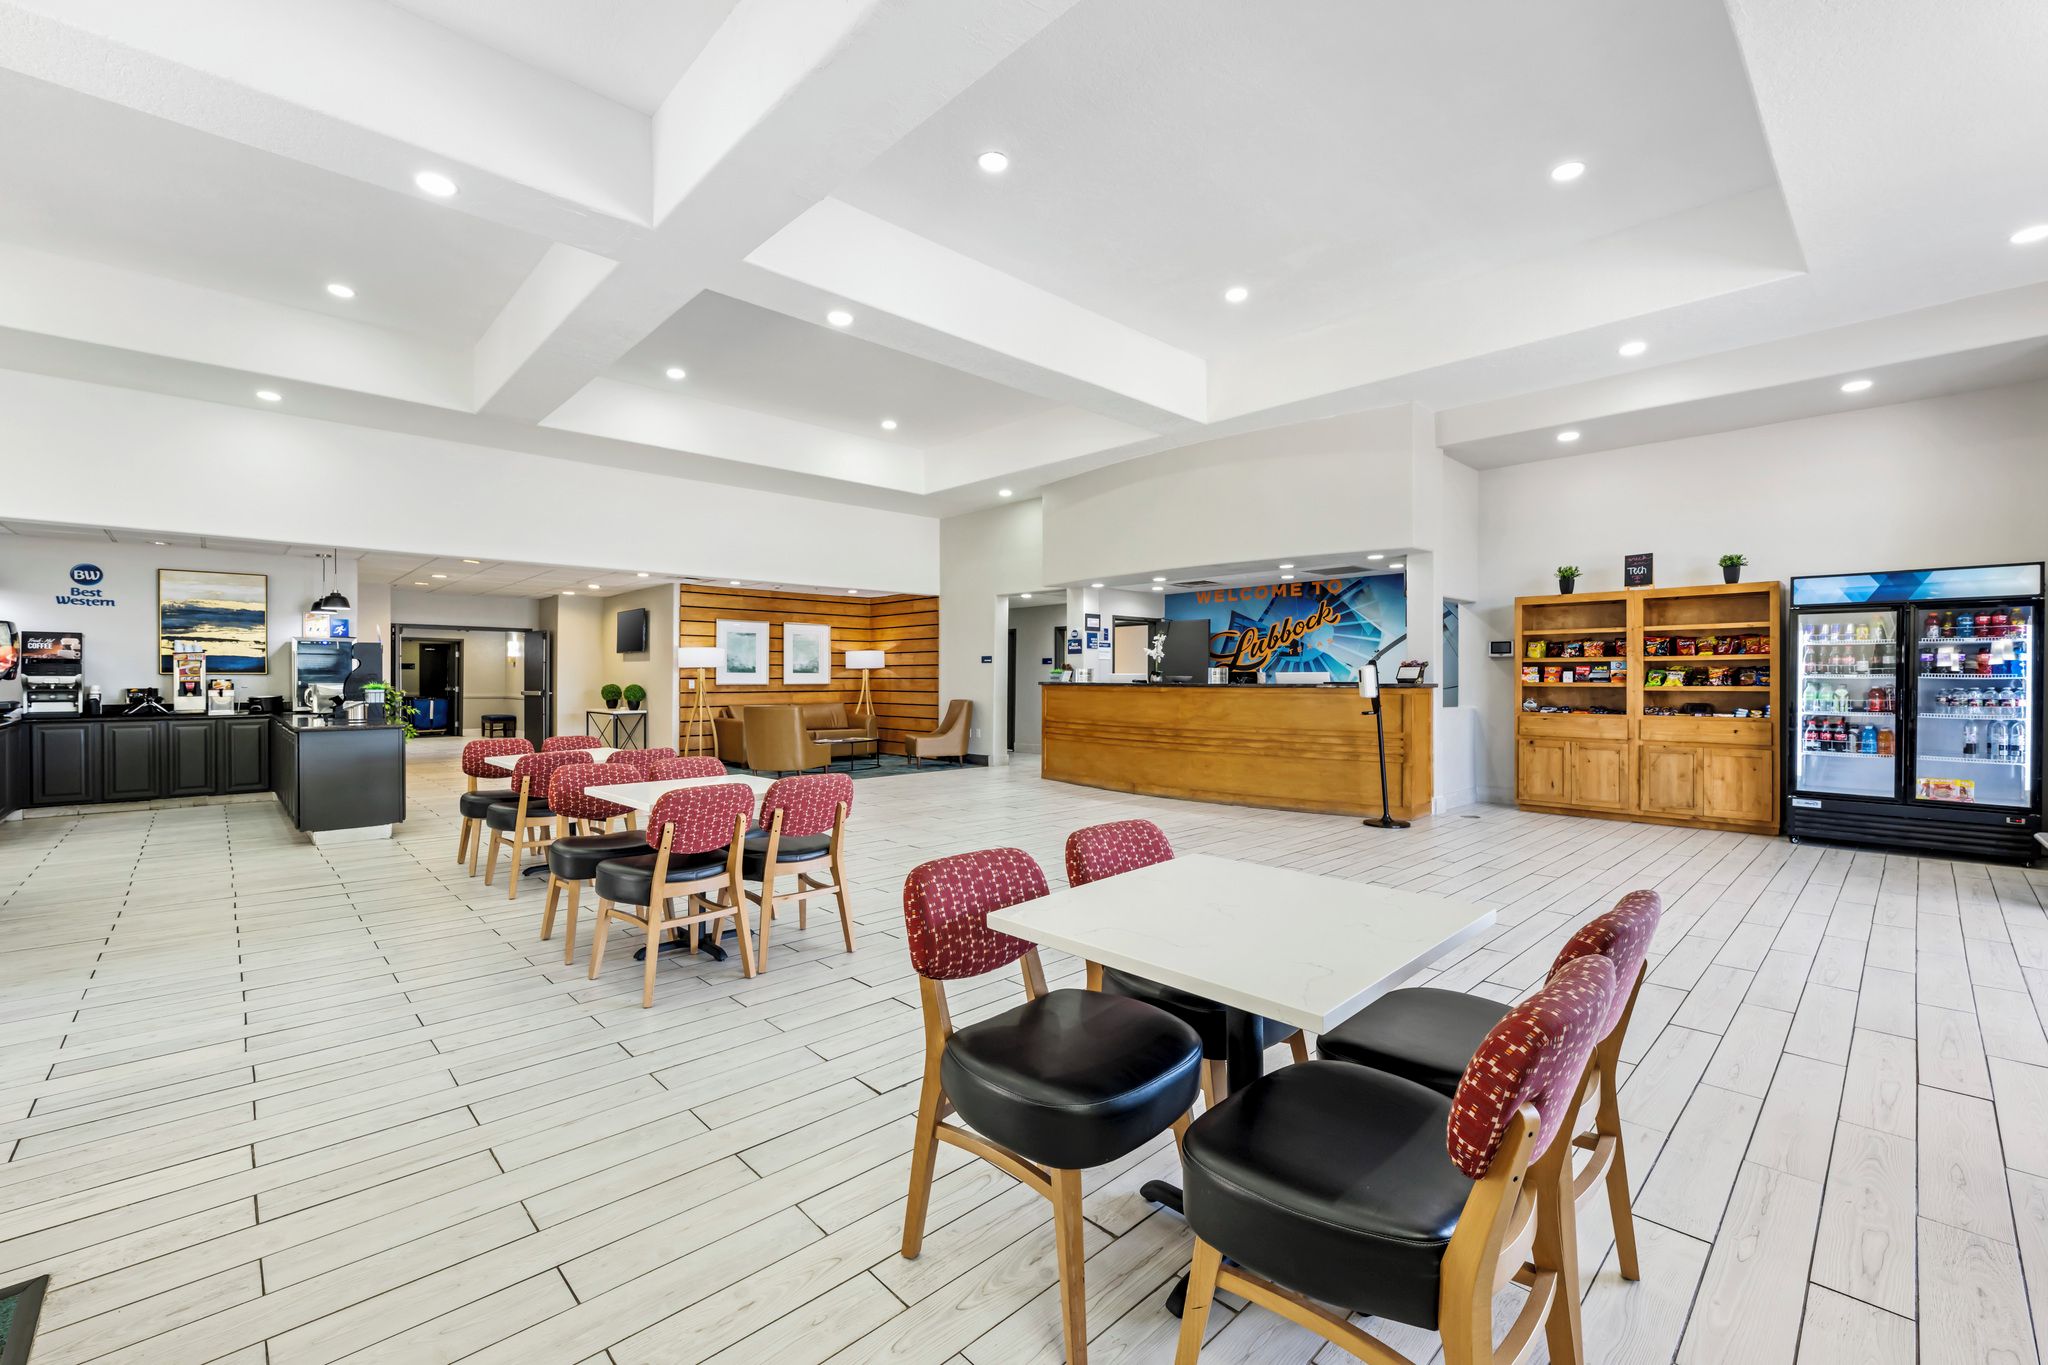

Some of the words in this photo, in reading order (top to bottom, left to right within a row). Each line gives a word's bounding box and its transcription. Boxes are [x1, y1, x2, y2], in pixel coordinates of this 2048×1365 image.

[73, 569, 100, 580] BW
[70, 587, 103, 597] Best
[1195, 582, 1303, 605] WELCOME
[1311, 578, 1343, 596] TO
[55, 595, 116, 607] Western
[1208, 599, 1342, 673] Lubbock
